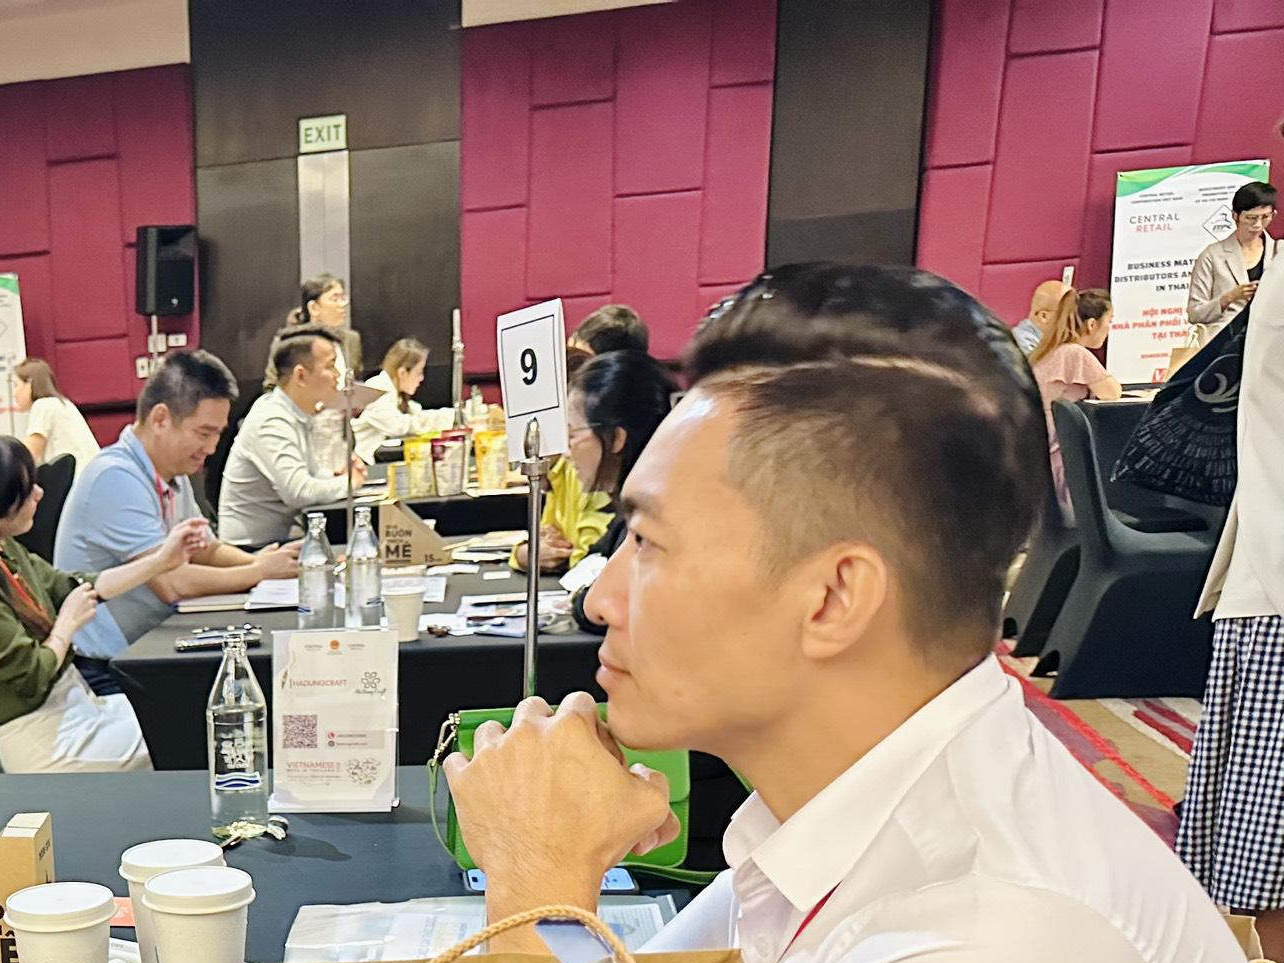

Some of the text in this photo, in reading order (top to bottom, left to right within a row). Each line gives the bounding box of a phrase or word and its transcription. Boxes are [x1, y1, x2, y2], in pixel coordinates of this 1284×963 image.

[304, 124, 342, 144] EXIT
[1129, 213, 1179, 224] CENTRAL
[1136, 223, 1172, 233] RETAIL
[1128, 261, 1171, 271] BUSINESS
[1114, 272, 1178, 283] DISTRIBUTORS
[521, 348, 537, 385] 9
